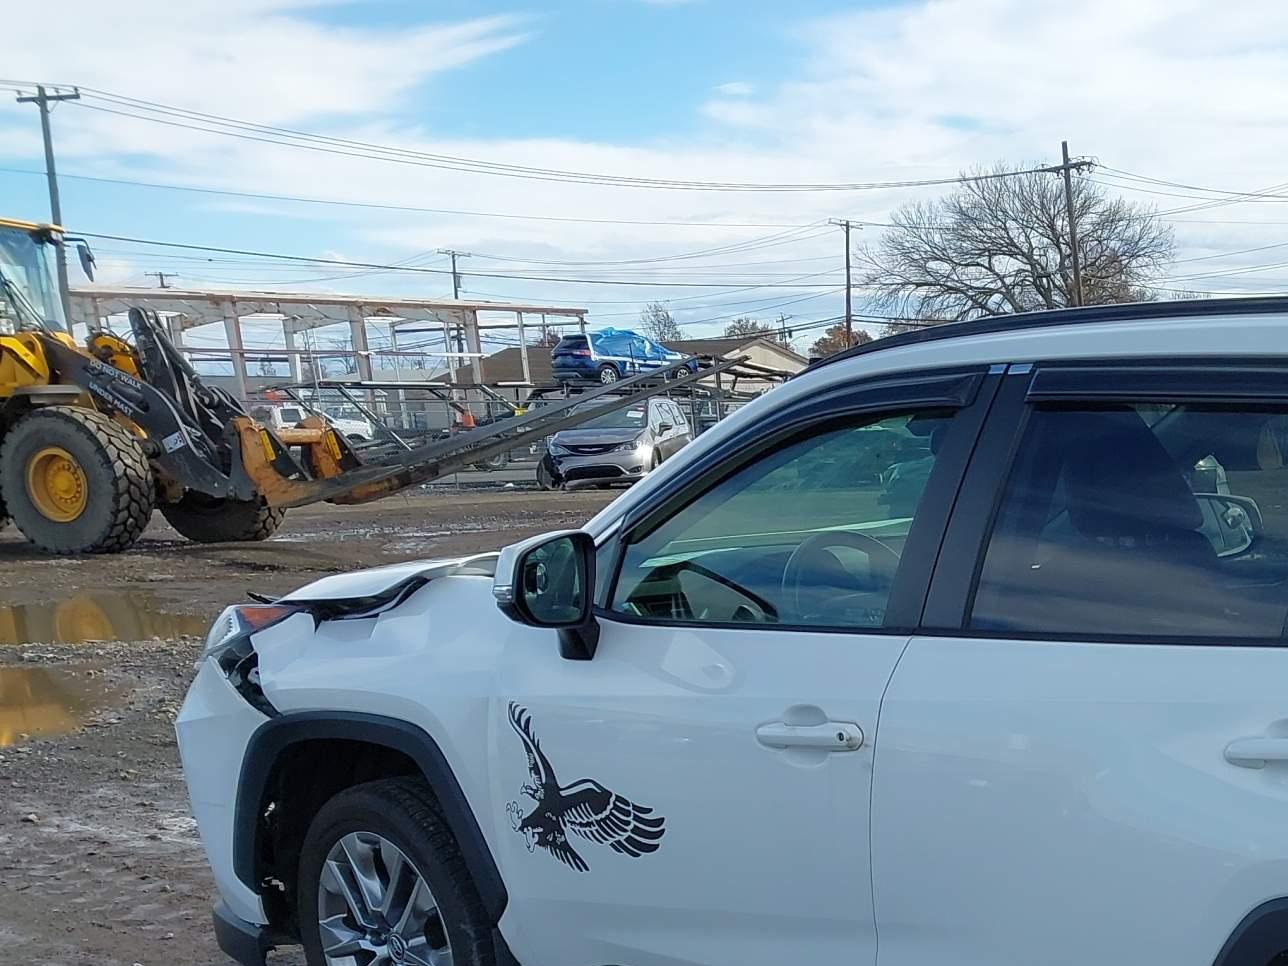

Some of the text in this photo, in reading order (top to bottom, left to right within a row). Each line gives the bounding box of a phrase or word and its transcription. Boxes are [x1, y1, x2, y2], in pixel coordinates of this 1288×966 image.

[102, 363, 119, 378] NOT
[120, 374, 142, 390] WALK
[88, 381, 133, 417] UNDER MAST
